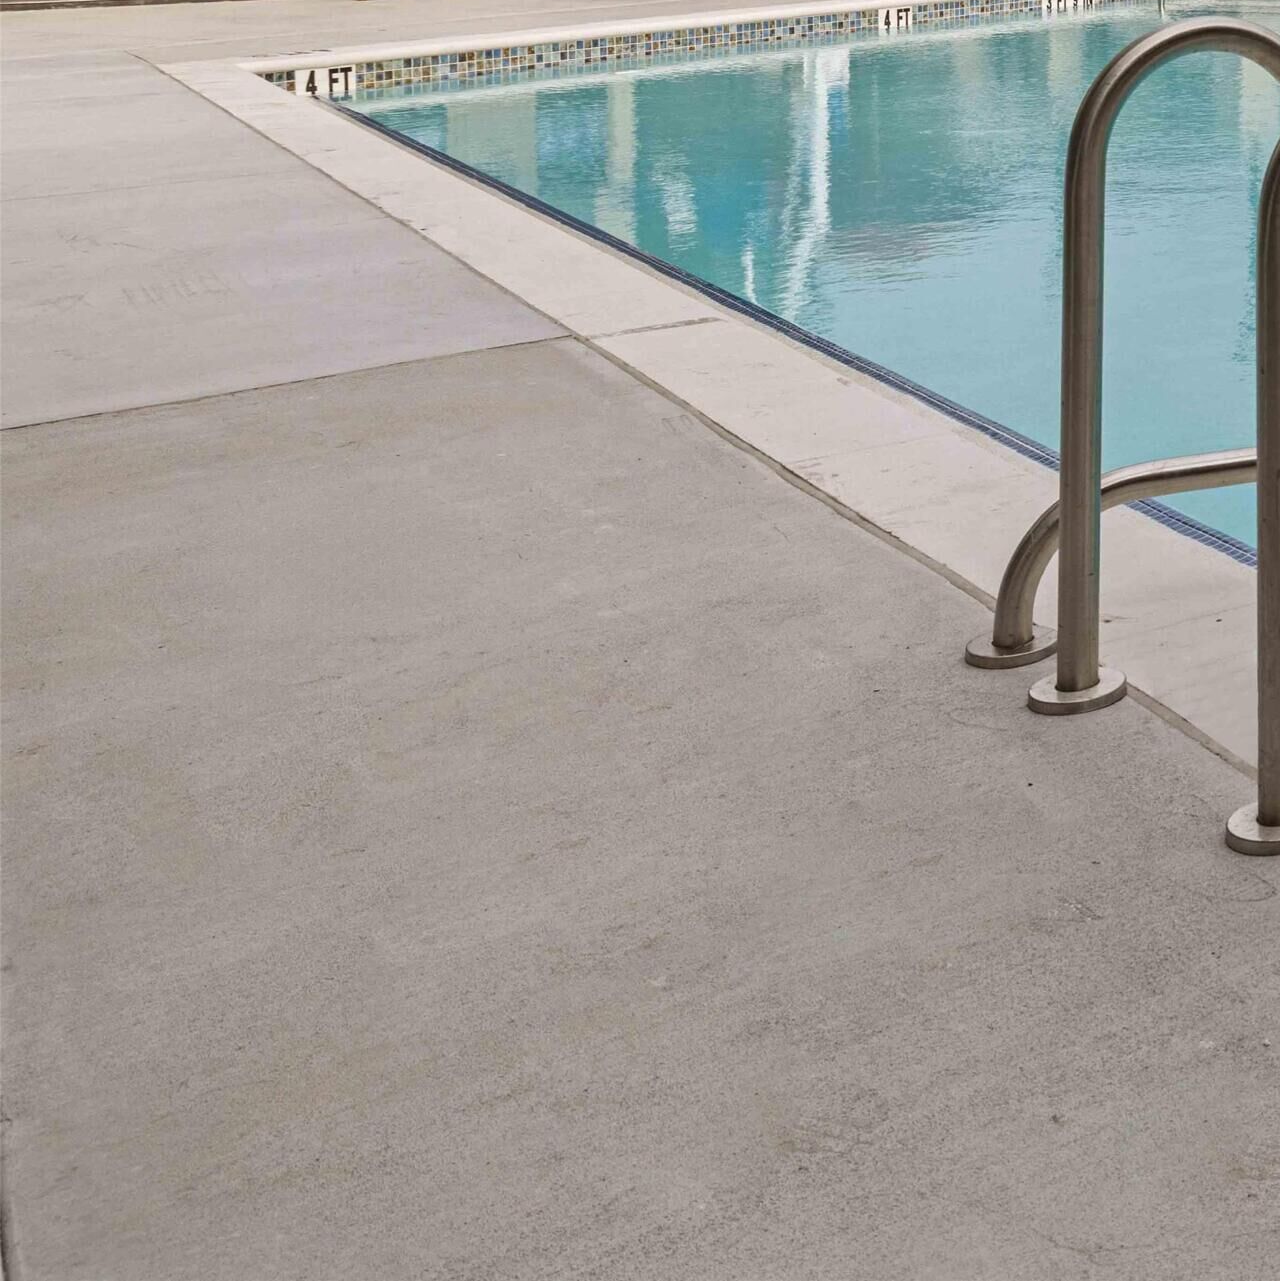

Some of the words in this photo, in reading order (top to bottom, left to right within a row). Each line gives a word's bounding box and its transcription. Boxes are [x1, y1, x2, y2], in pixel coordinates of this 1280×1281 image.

[884, 9, 891, 29] 4
[897, 7, 911, 28] FT
[305, 70, 318, 95] 4
[328, 67, 352, 93] FT
